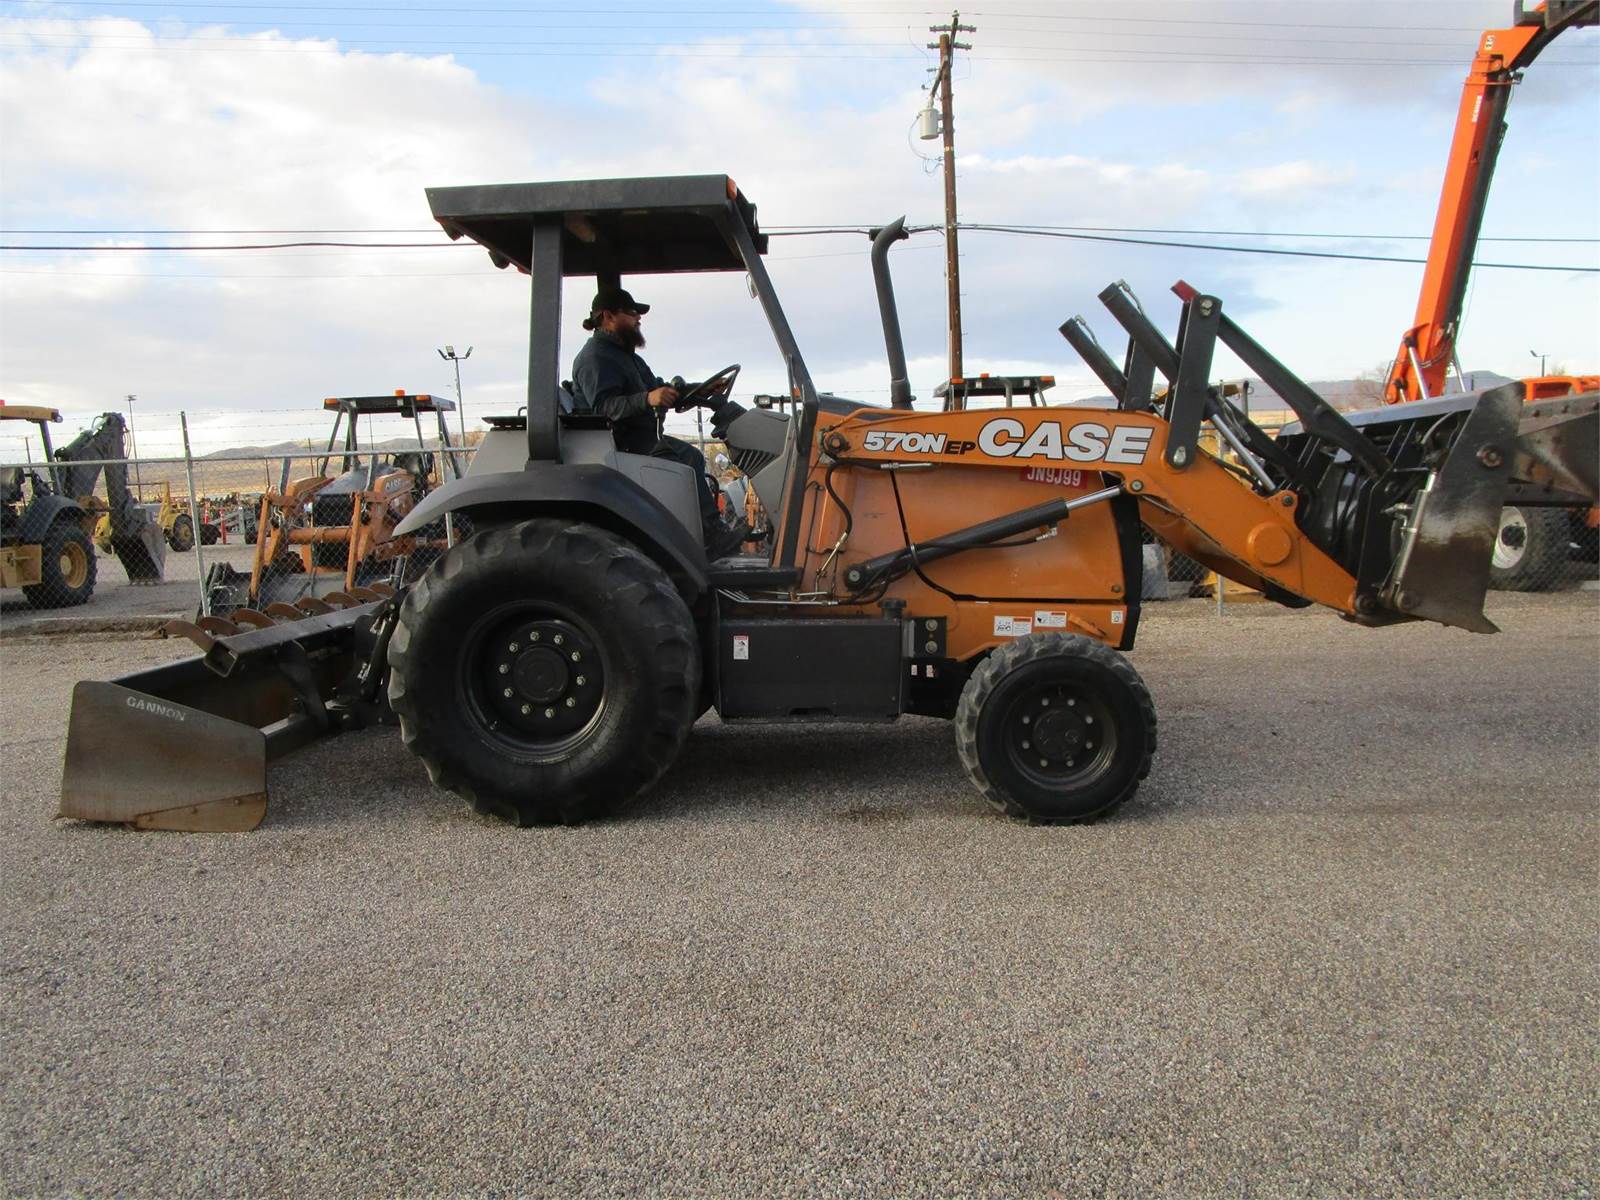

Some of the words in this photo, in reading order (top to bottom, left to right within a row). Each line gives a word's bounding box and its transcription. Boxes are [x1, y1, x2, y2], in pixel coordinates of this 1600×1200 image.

[863, 431, 947, 454] 570N
[945, 441, 976, 455] EP
[978, 417, 1155, 465] CASE
[126, 696, 186, 721] GANNON
